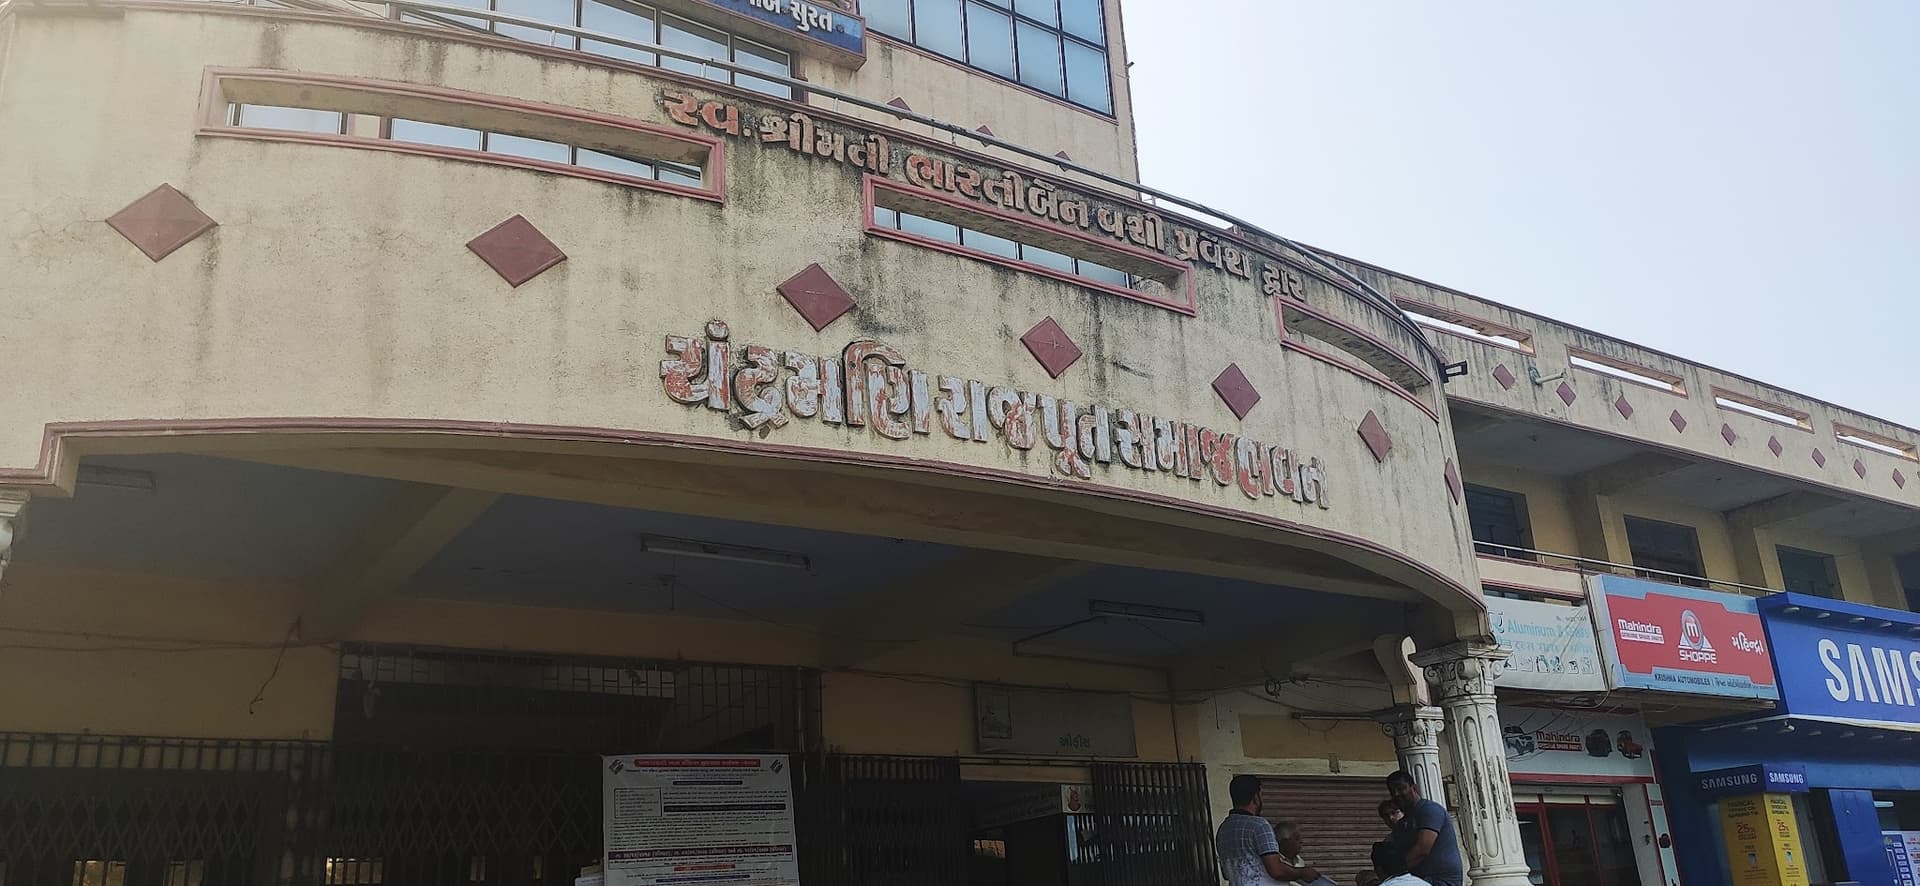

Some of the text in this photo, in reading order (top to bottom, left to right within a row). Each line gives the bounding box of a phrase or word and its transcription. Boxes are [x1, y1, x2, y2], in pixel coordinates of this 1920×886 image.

[790, 0, 833, 33] સુરત
[758, 112, 890, 177] શ્રીમતી
[1097, 205, 1166, 252] વશી
[1174, 228, 1252, 280] પ્રવેશ
[1617, 618, 1663, 635] Mahindra
[1731, 631, 1765, 656] મહિન્દ્રા
[1679, 649, 1718, 665] SHOPPE
[1536, 730, 1580, 743] Mahindra
[1701, 772, 1758, 790] SAMSUNG
[1768, 771, 1805, 785] SAMSUNG
